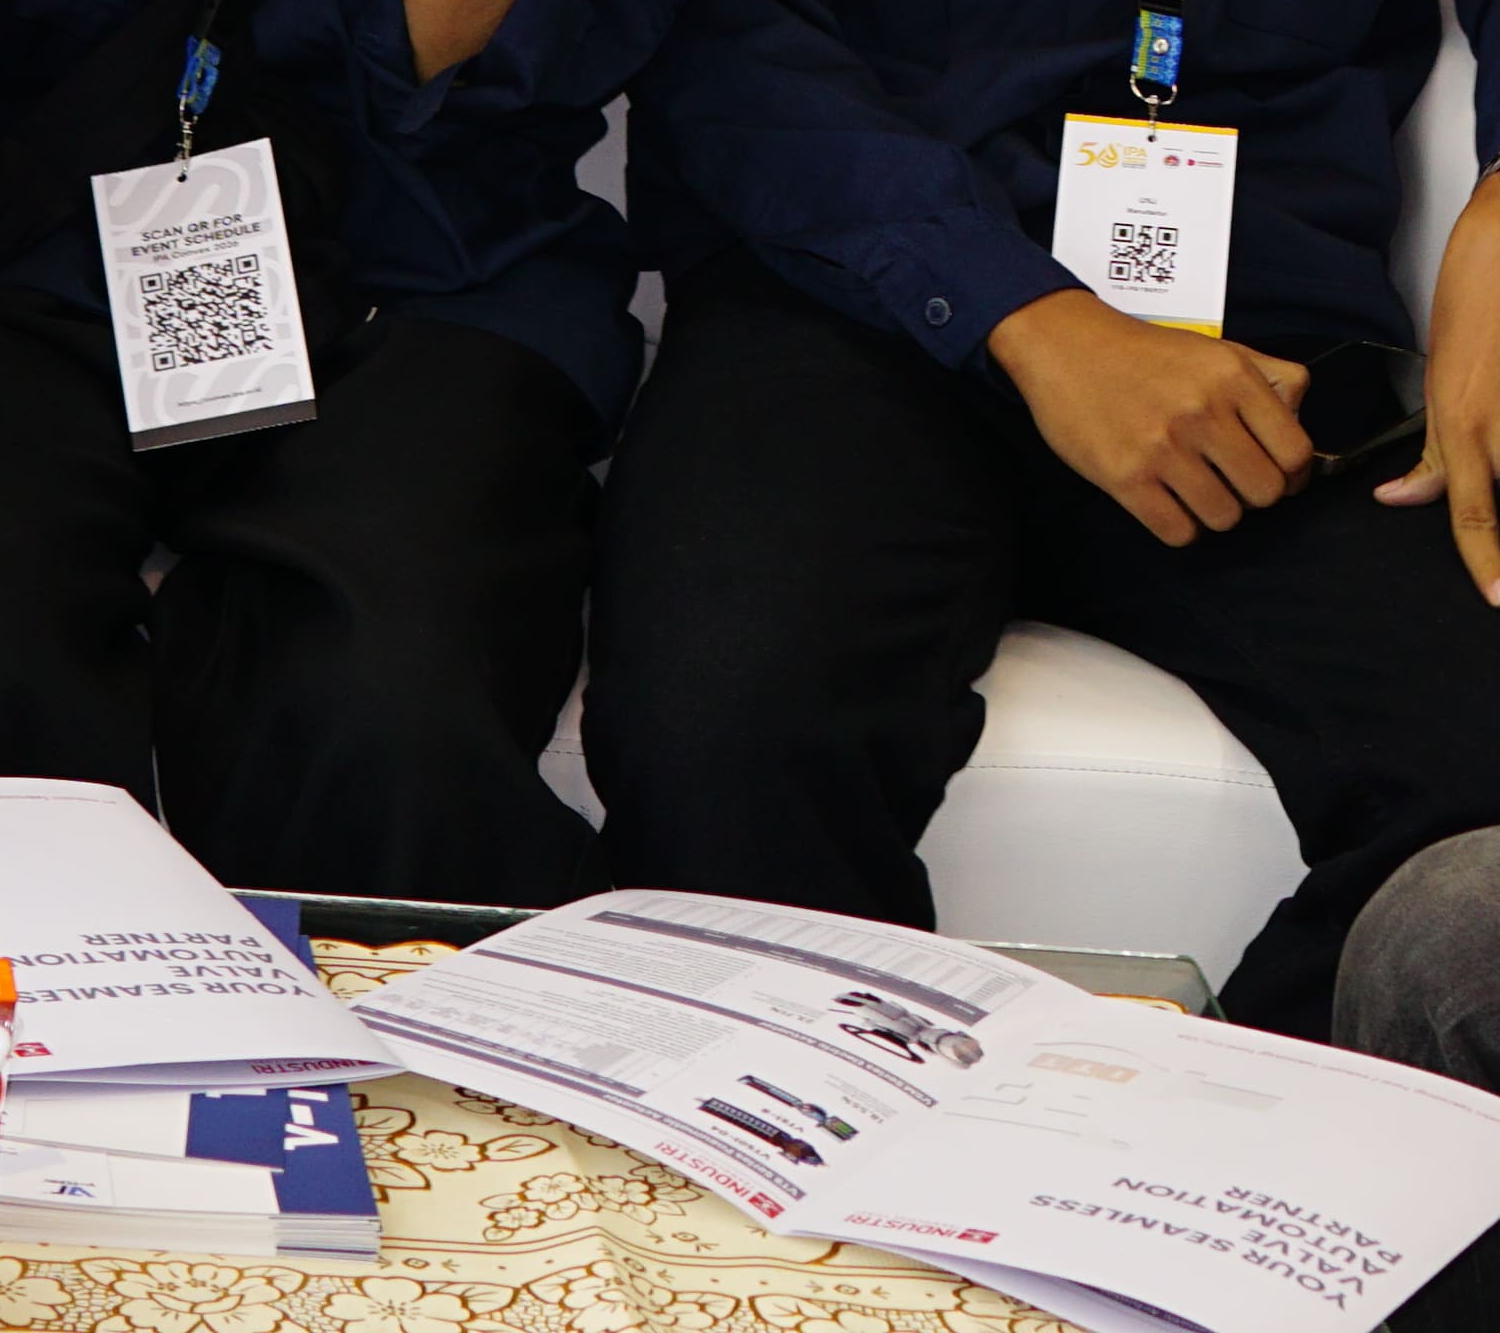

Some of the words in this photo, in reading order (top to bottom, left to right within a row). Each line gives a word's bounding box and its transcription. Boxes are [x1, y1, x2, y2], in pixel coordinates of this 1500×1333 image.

[132, 237, 179, 258] EVENT
[184, 222, 262, 249] SCHEDULE
[140, 223, 184, 244] SCAN
[186, 218, 211, 234] QR
[212, 213, 245, 229] FOR
[80, 932, 264, 949] PARTNER
[8, 948, 275, 968] AUTOMATION
[170, 965, 300, 983] VALVE
[16, 982, 197, 1005] SEAMLES
[198, 981, 316, 999] YOUR
[653, 1140, 750, 1199] INDUSTRI
[844, 1213, 957, 1239] INDUSTRI
[1028, 1194, 1236, 1254] SEAMLESS
[1111, 1176, 1390, 1277] AUTOMATION
[1224, 1185, 1404, 1267] PARTNER
[1241, 1229, 1365, 1297] VALVE
[1241, 1248, 1347, 1312] YOUR
